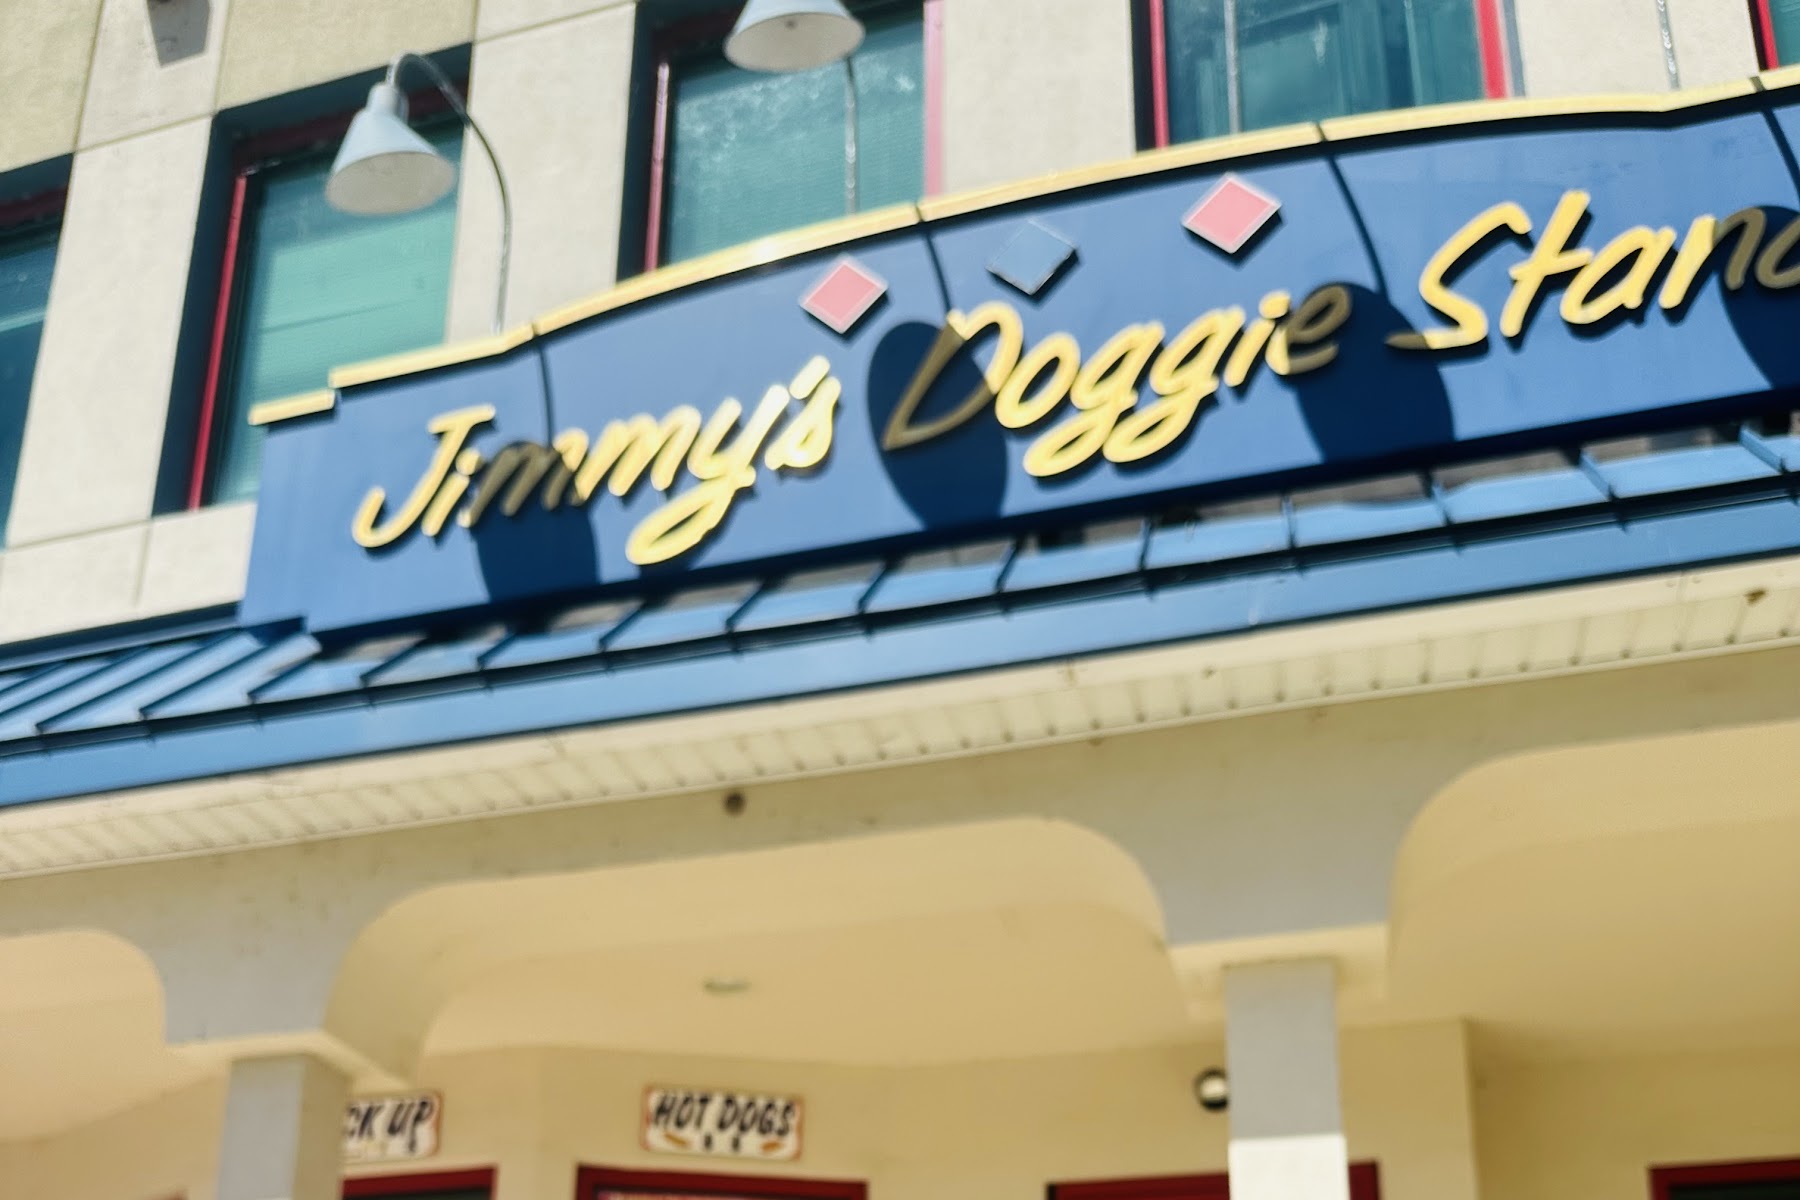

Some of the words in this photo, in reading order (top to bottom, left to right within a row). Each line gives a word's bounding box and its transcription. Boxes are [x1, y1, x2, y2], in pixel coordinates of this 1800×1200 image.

[352, 355, 842, 566] Jimmy's
[882, 300, 1353, 478] Doggie
[386, 1098, 434, 1141] UP
[654, 1095, 712, 1131] HOT
[717, 1096, 796, 1137] DOGS
